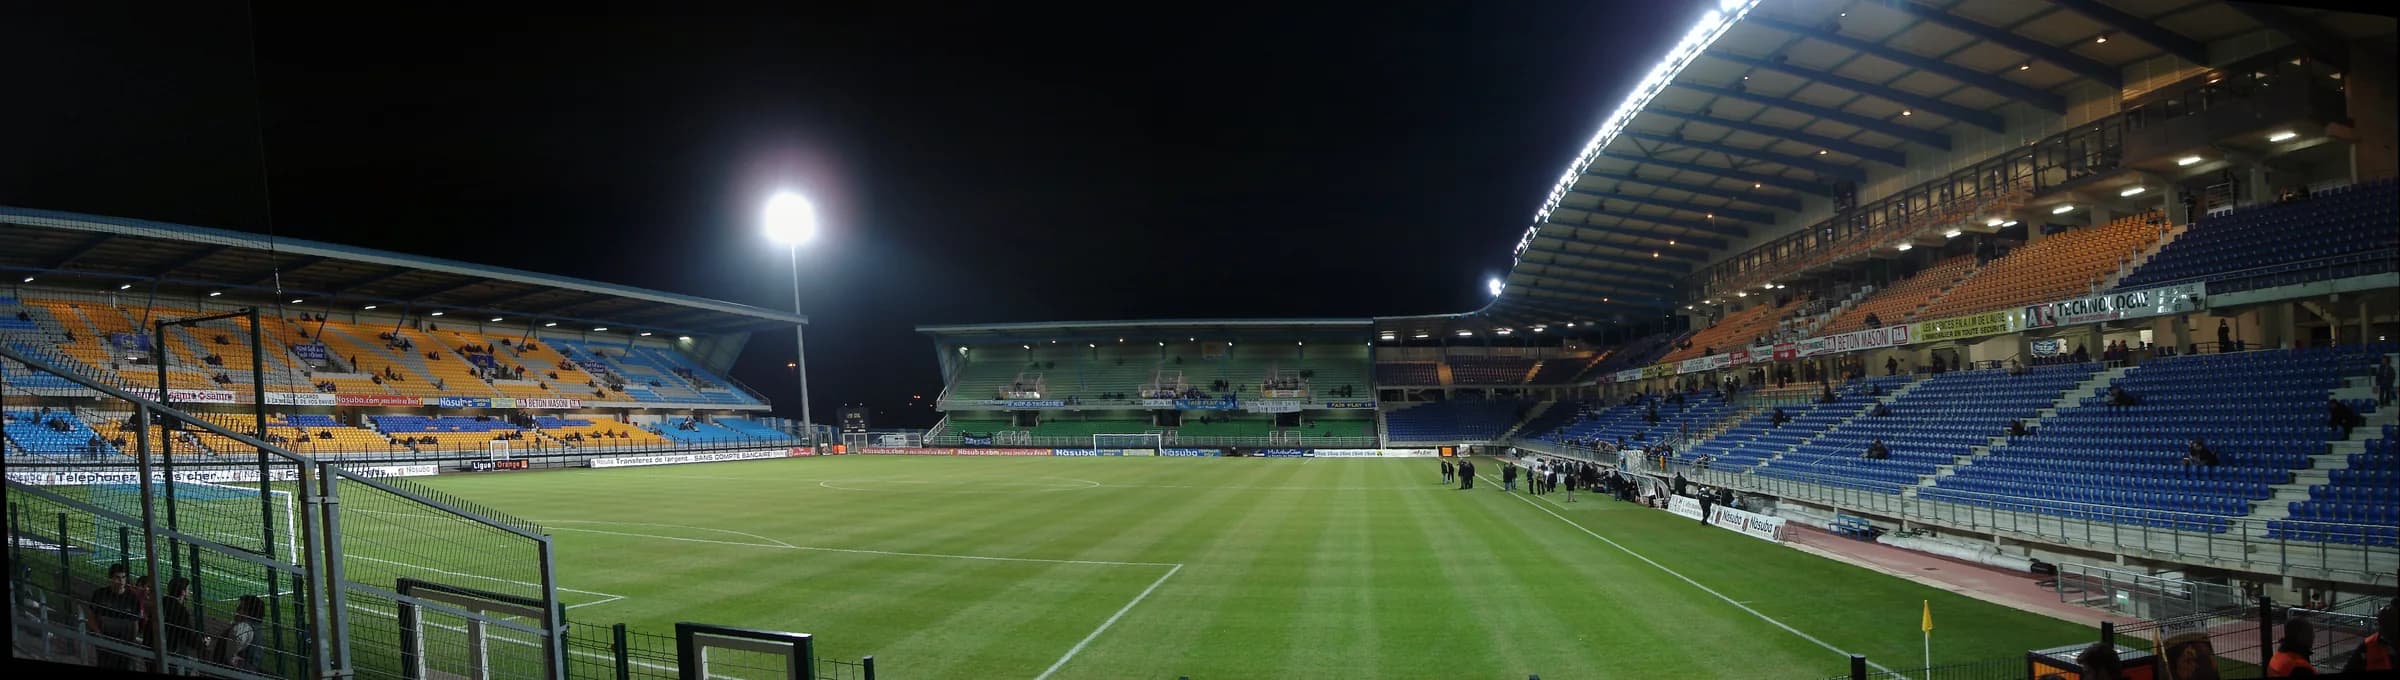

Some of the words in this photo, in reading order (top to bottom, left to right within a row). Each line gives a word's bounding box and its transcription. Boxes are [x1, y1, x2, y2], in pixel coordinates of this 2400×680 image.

[1837, 333, 1860, 350] BETON
[1861, 328, 1889, 347] MASONI
[473, 461, 491, 470] Ligue
[497, 460, 520, 469] Orange
